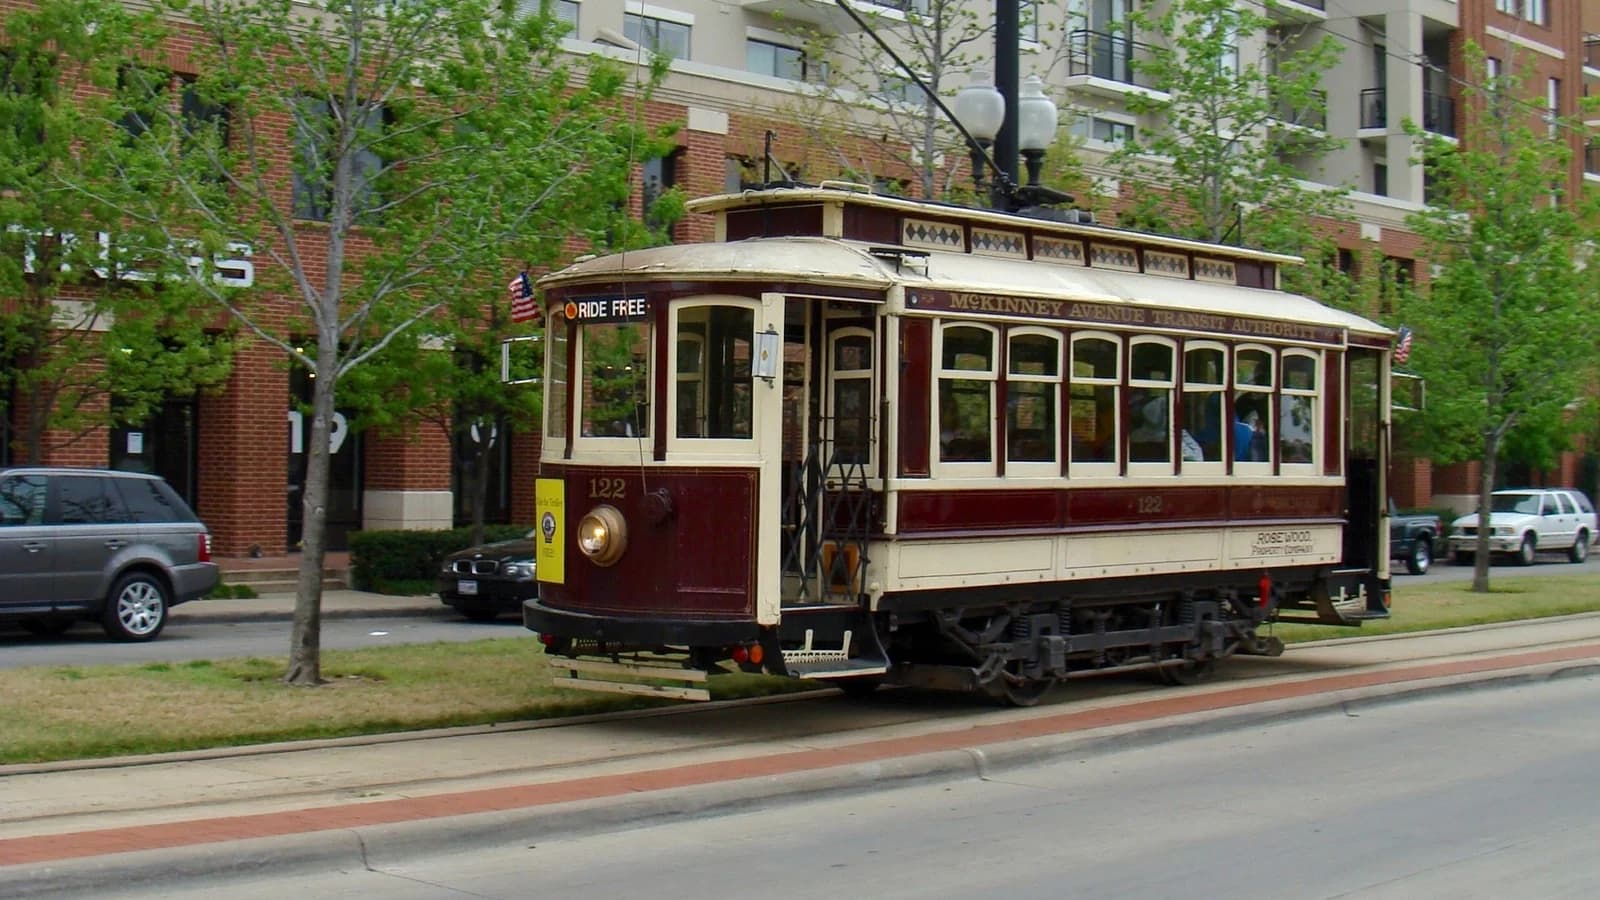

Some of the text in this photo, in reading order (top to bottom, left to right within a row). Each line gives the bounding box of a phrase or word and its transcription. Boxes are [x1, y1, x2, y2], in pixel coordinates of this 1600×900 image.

[578, 298, 645, 318] RIDE FREE
[1070, 303, 1145, 323] AVENUE
[1153, 310, 1227, 331] TRANSIT
[1232, 318, 1317, 339] AUTHORITY
[589, 478, 626, 498] 122
[1137, 496, 1162, 513] 122
